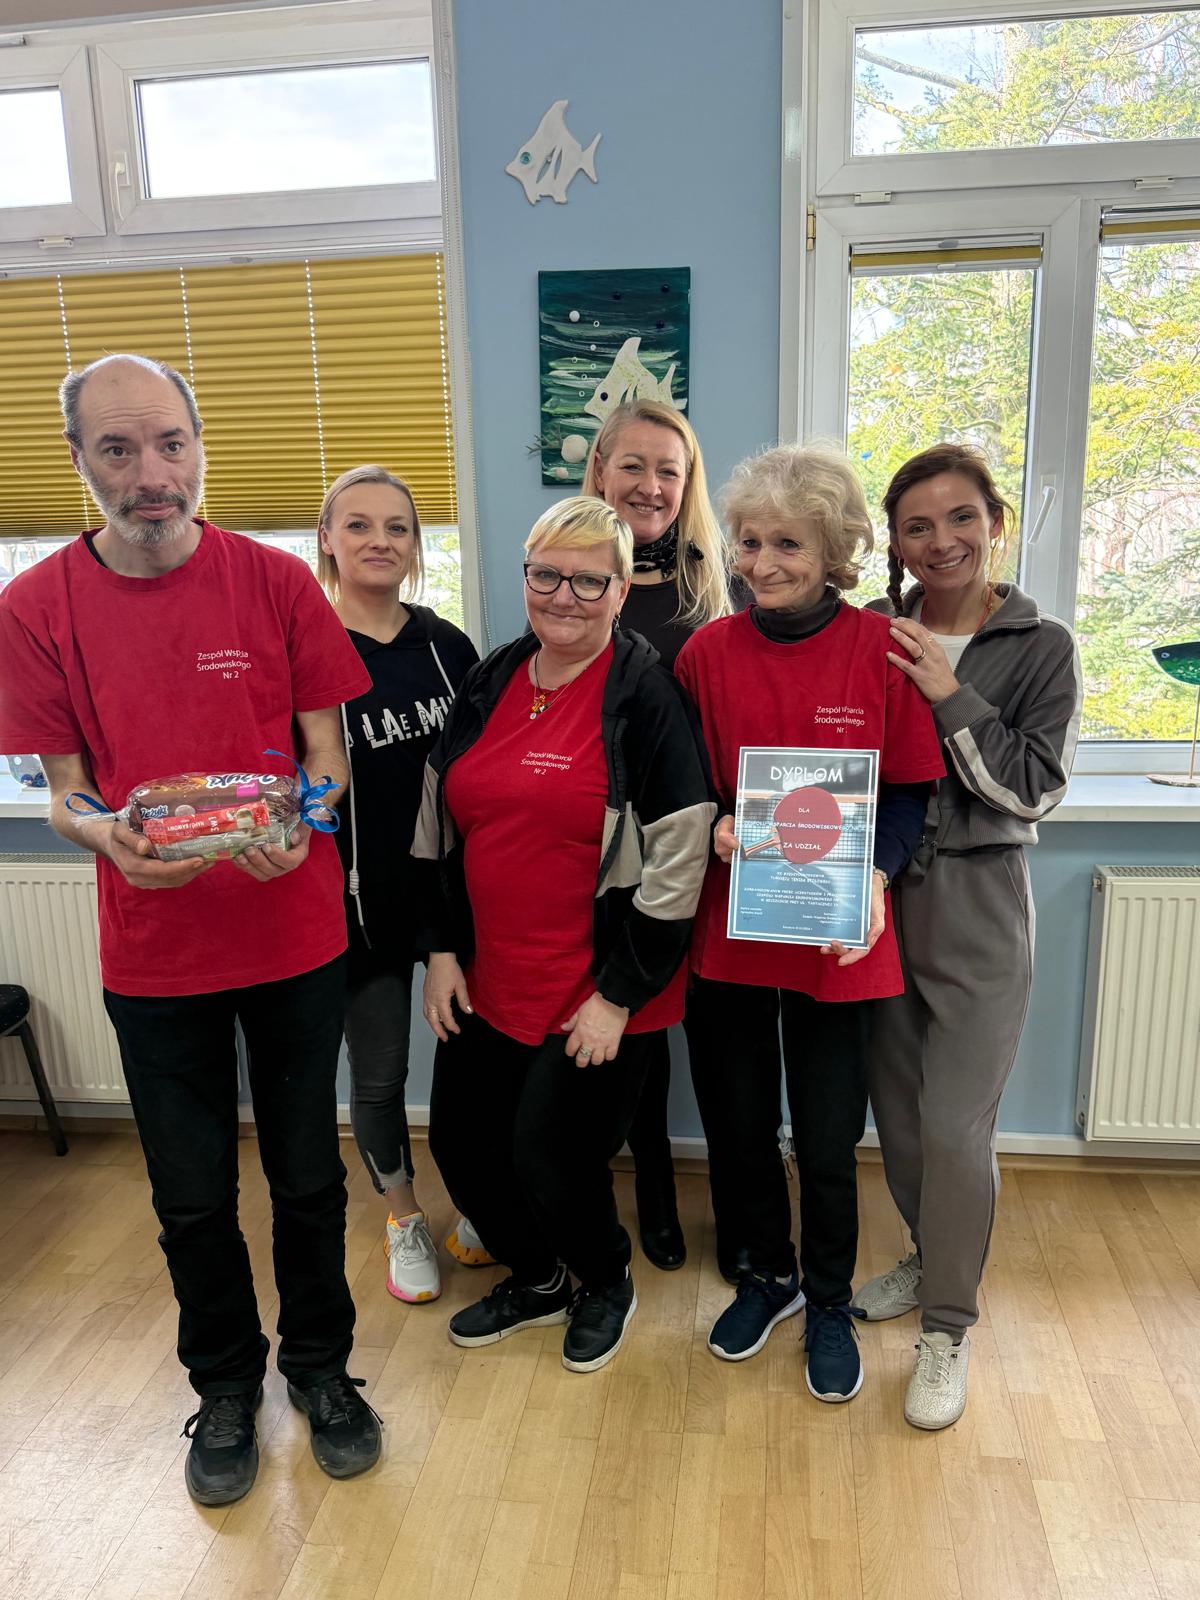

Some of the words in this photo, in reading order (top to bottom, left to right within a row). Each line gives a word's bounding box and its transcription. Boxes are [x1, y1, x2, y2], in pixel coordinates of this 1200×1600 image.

[222, 671, 232, 679] Nr
[233, 670, 239, 679] 2
[770, 766, 843, 783] DYPLOM
